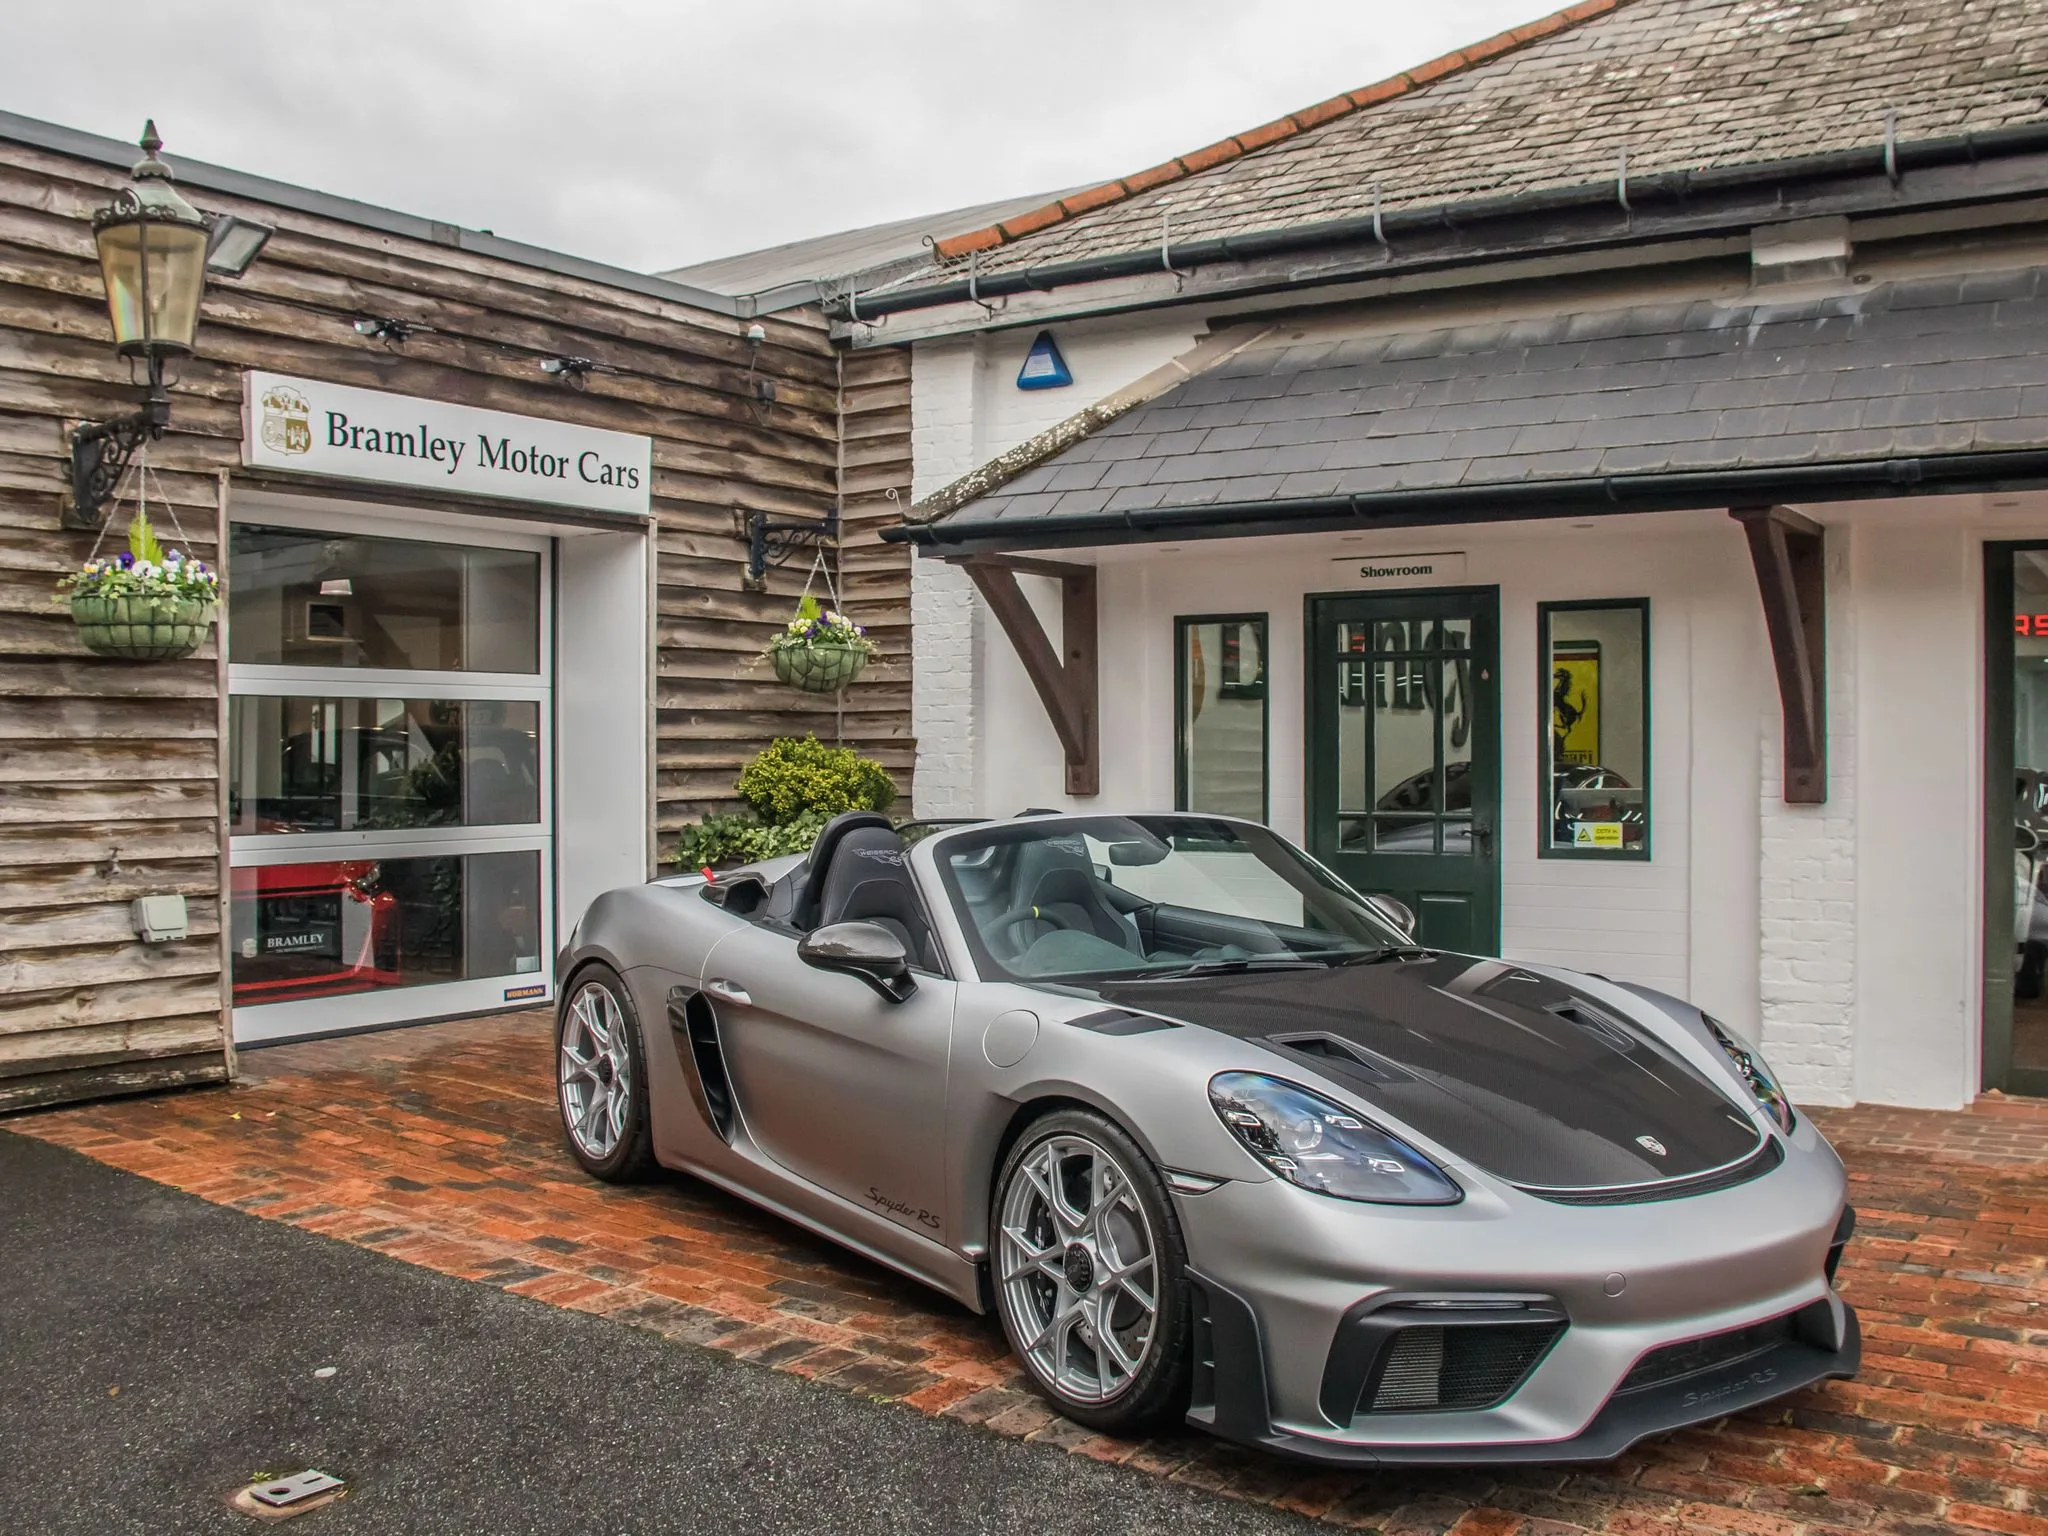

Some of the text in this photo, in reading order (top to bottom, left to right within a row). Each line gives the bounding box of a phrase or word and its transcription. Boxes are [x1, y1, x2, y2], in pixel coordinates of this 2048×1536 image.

[325, 410, 639, 489] Bramley Motor Cars
[1360, 565, 1432, 578] Showroom
[267, 933, 325, 948] BRAMLEY
[864, 1187, 941, 1229] Spyder RS
